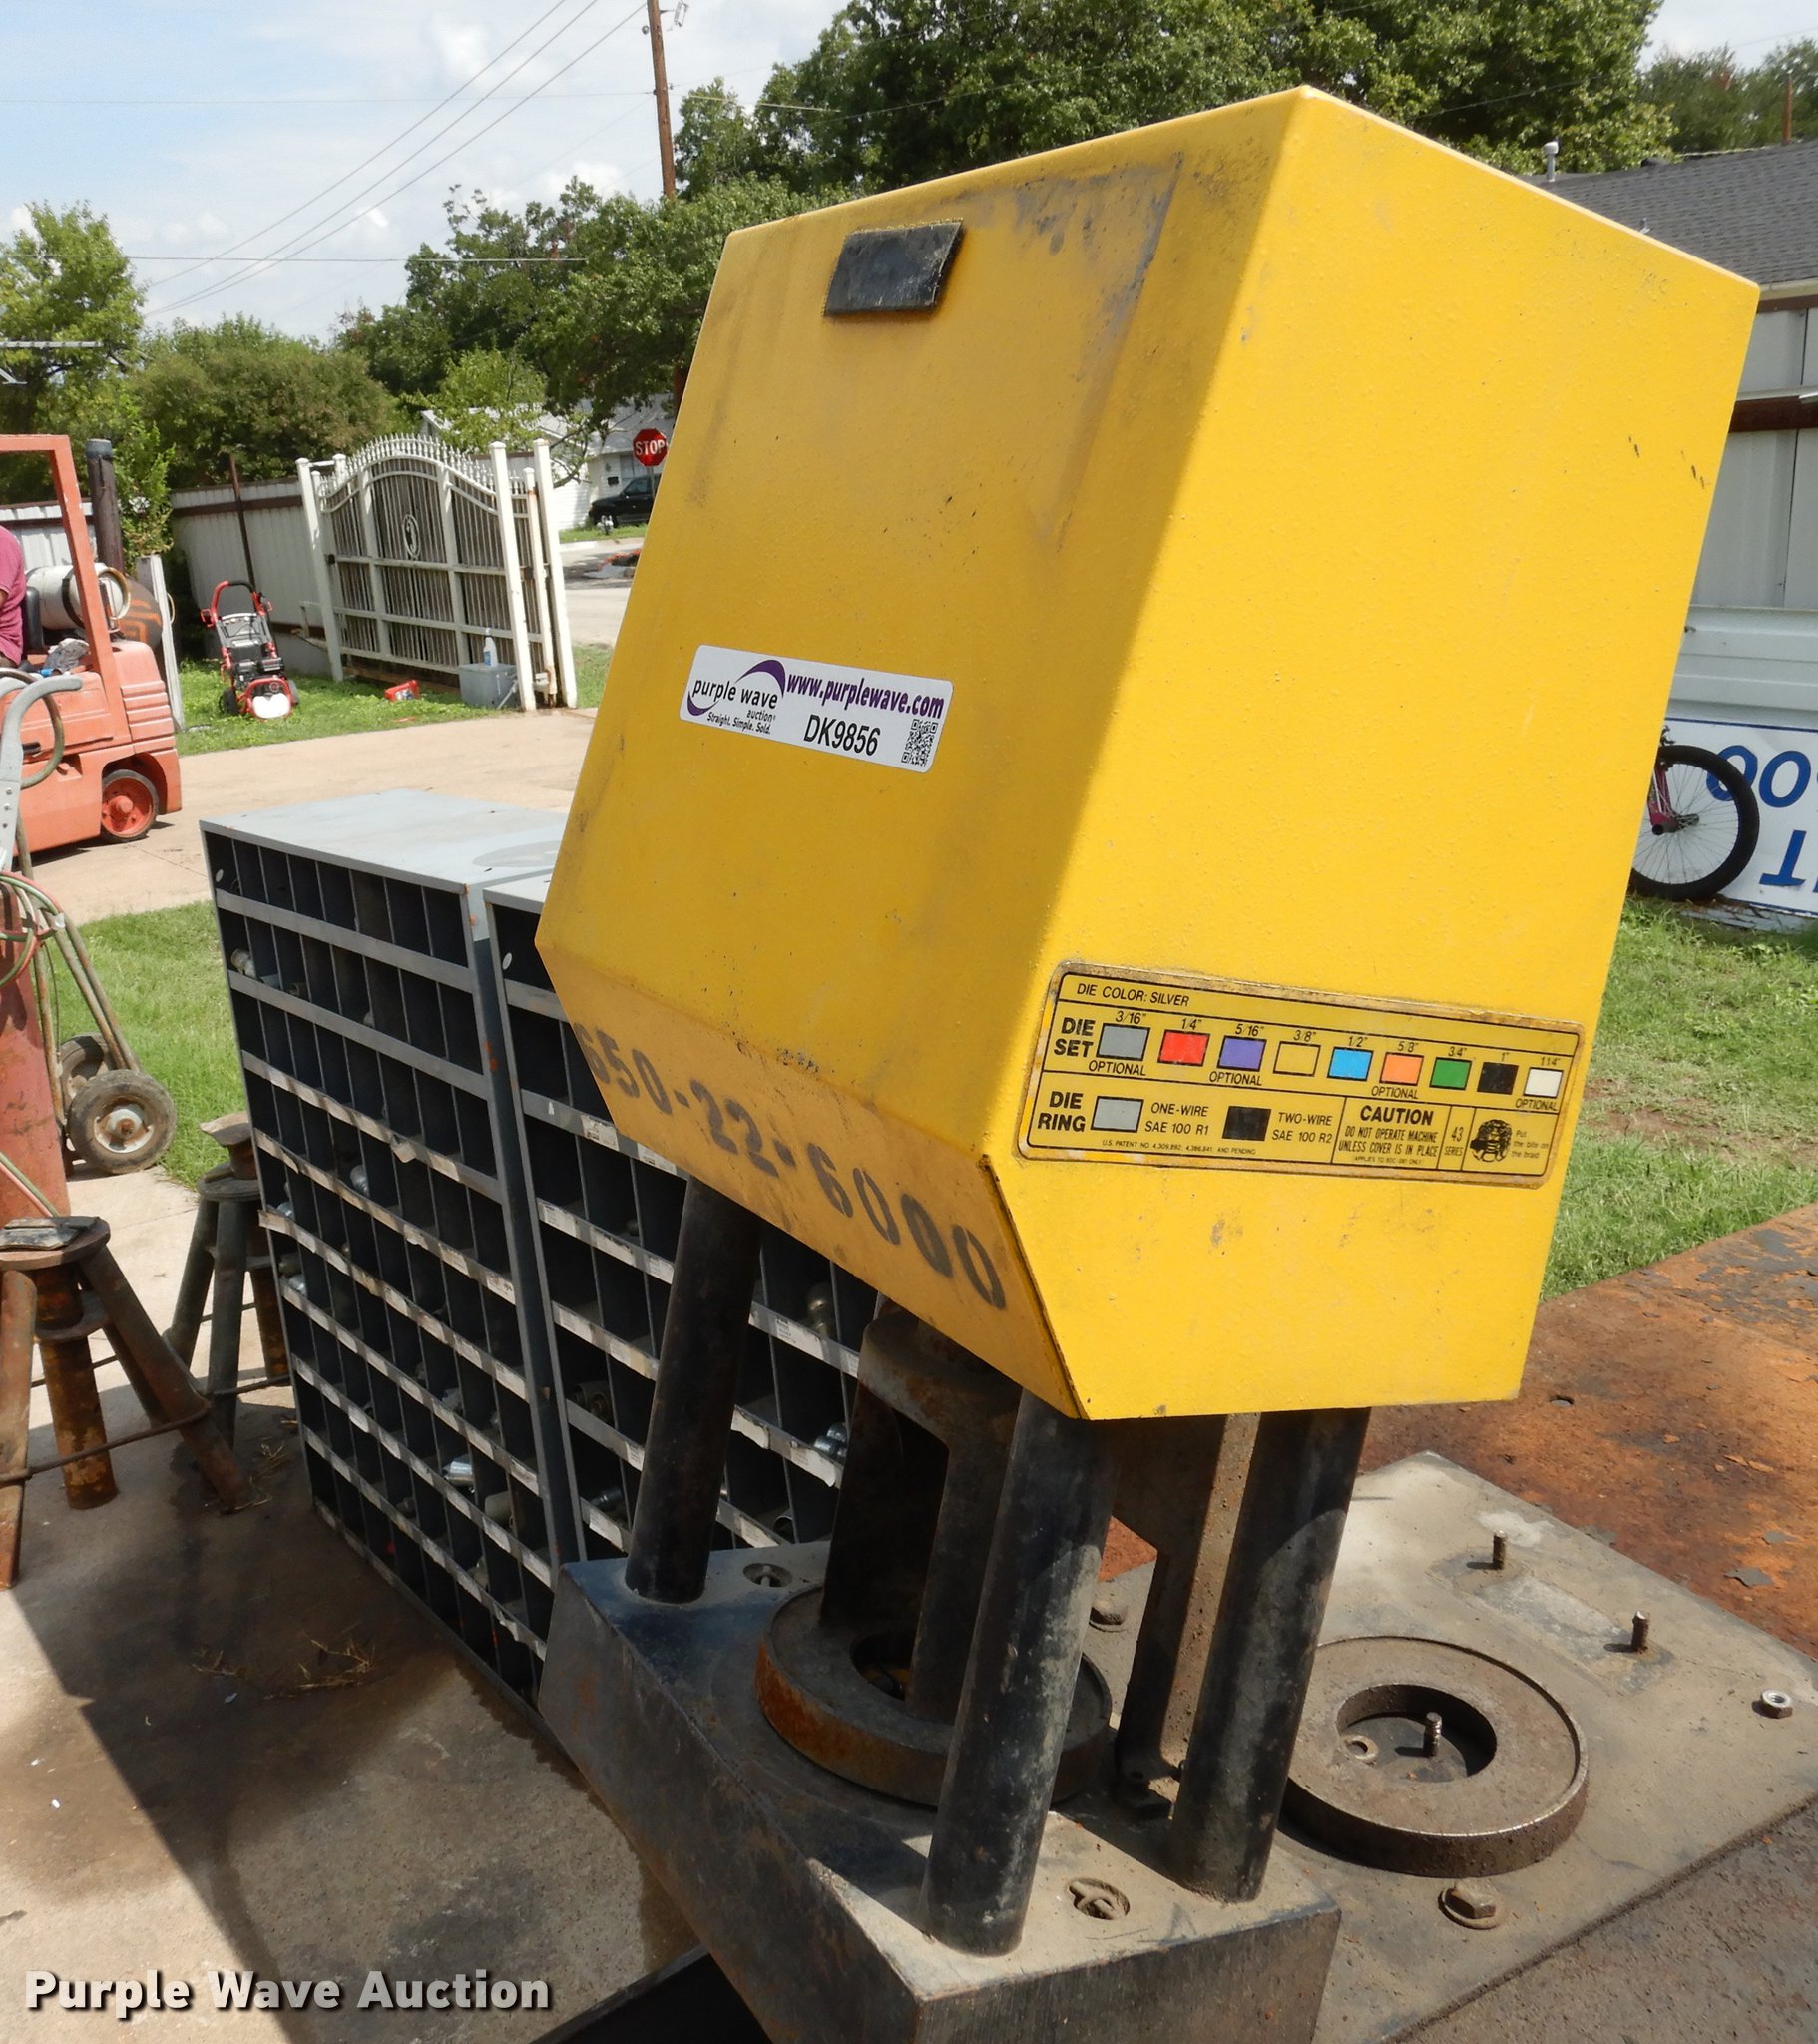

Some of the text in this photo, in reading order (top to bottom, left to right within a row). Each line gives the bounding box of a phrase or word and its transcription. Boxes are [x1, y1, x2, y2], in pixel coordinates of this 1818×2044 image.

[636, 439, 665, 456] STOP
[692, 678, 778, 710] purple wave
[786, 674, 945, 719] www.purplewave.com
[706, 711, 771, 735] Straight. Simple. Sold.
[803, 714, 881, 756] DK9856
[1077, 983, 1190, 1007] DIE COLOR: SILVER
[1061, 1016, 1096, 1037] DIE
[1054, 1039, 1094, 1058] SET
[1088, 1060, 1146, 1077] OPTIONAL
[1208, 1071, 1262, 1086] OPTIONAL
[1049, 1091, 1084, 1110] DIE
[1371, 1085, 1419, 1099] OPTIONAL
[1515, 1098, 1559, 1112] OPTIONAL
[1037, 1112, 1087, 1133] RING
[1278, 1112, 1333, 1126] TWO-WIRE
[1360, 1105, 1434, 1126] CAUTION
[1144, 1120, 1209, 1136] SAE 100 R1
[1271, 1129, 1333, 1144] SAE 100 R2
[1344, 1125, 1438, 1143] DO NOT OPERATE MACHINE
[1451, 1126, 1464, 1142] 43
[1338, 1139, 1439, 1158] UNLESS COVER IS IN PLACE
[1444, 1146, 1464, 1157] SERIES
